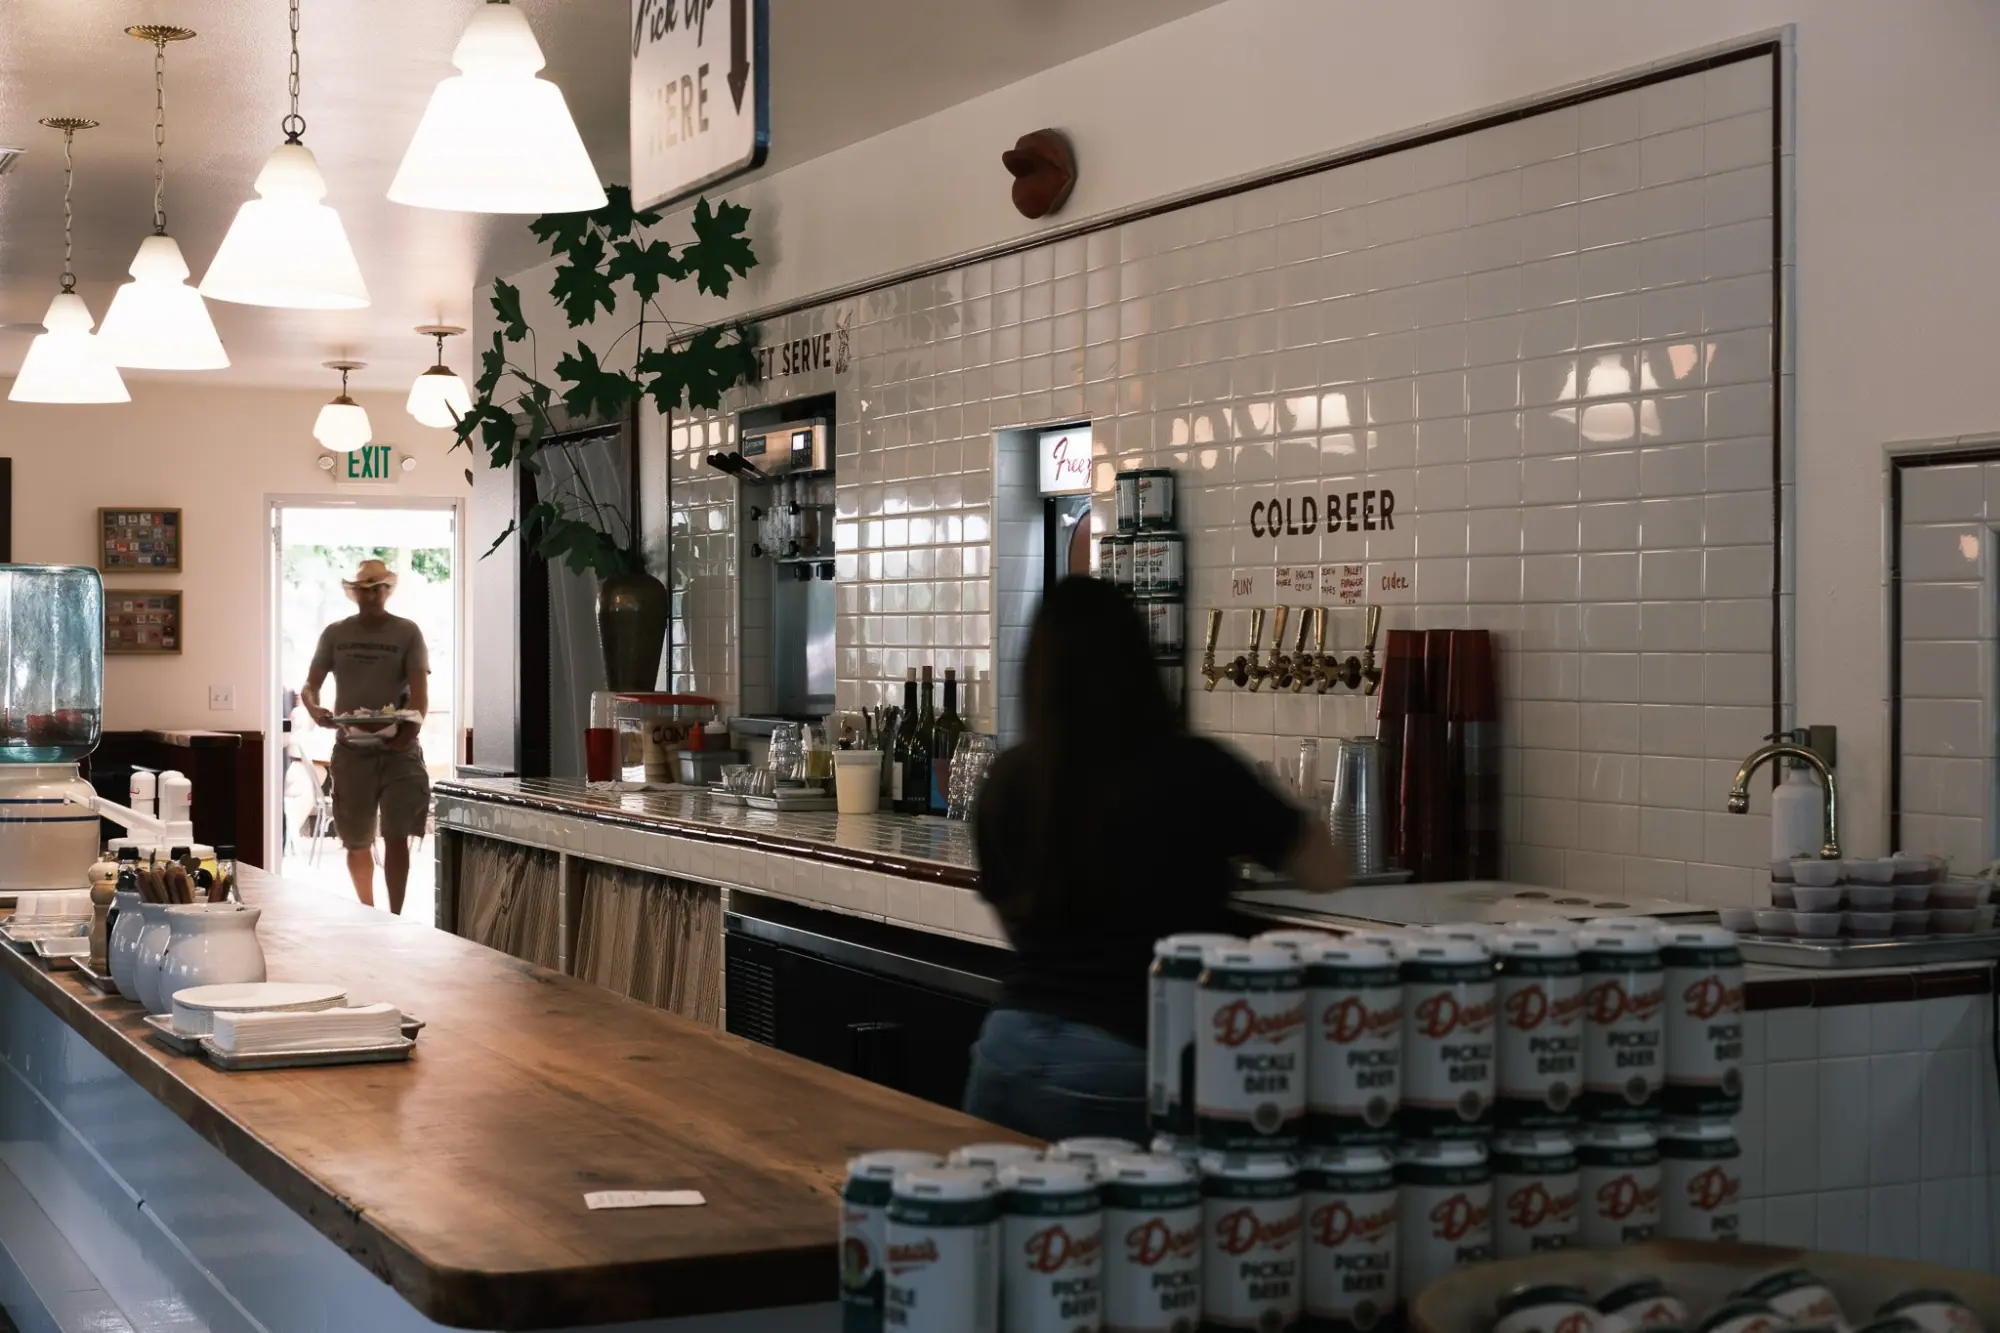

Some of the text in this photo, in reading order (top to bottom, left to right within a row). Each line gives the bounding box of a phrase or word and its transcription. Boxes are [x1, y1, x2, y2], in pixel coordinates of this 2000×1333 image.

[782, 332, 832, 376] SERVE
[348, 445, 392, 479] EXIT
[1251, 489, 1395, 538] COLD BEER
